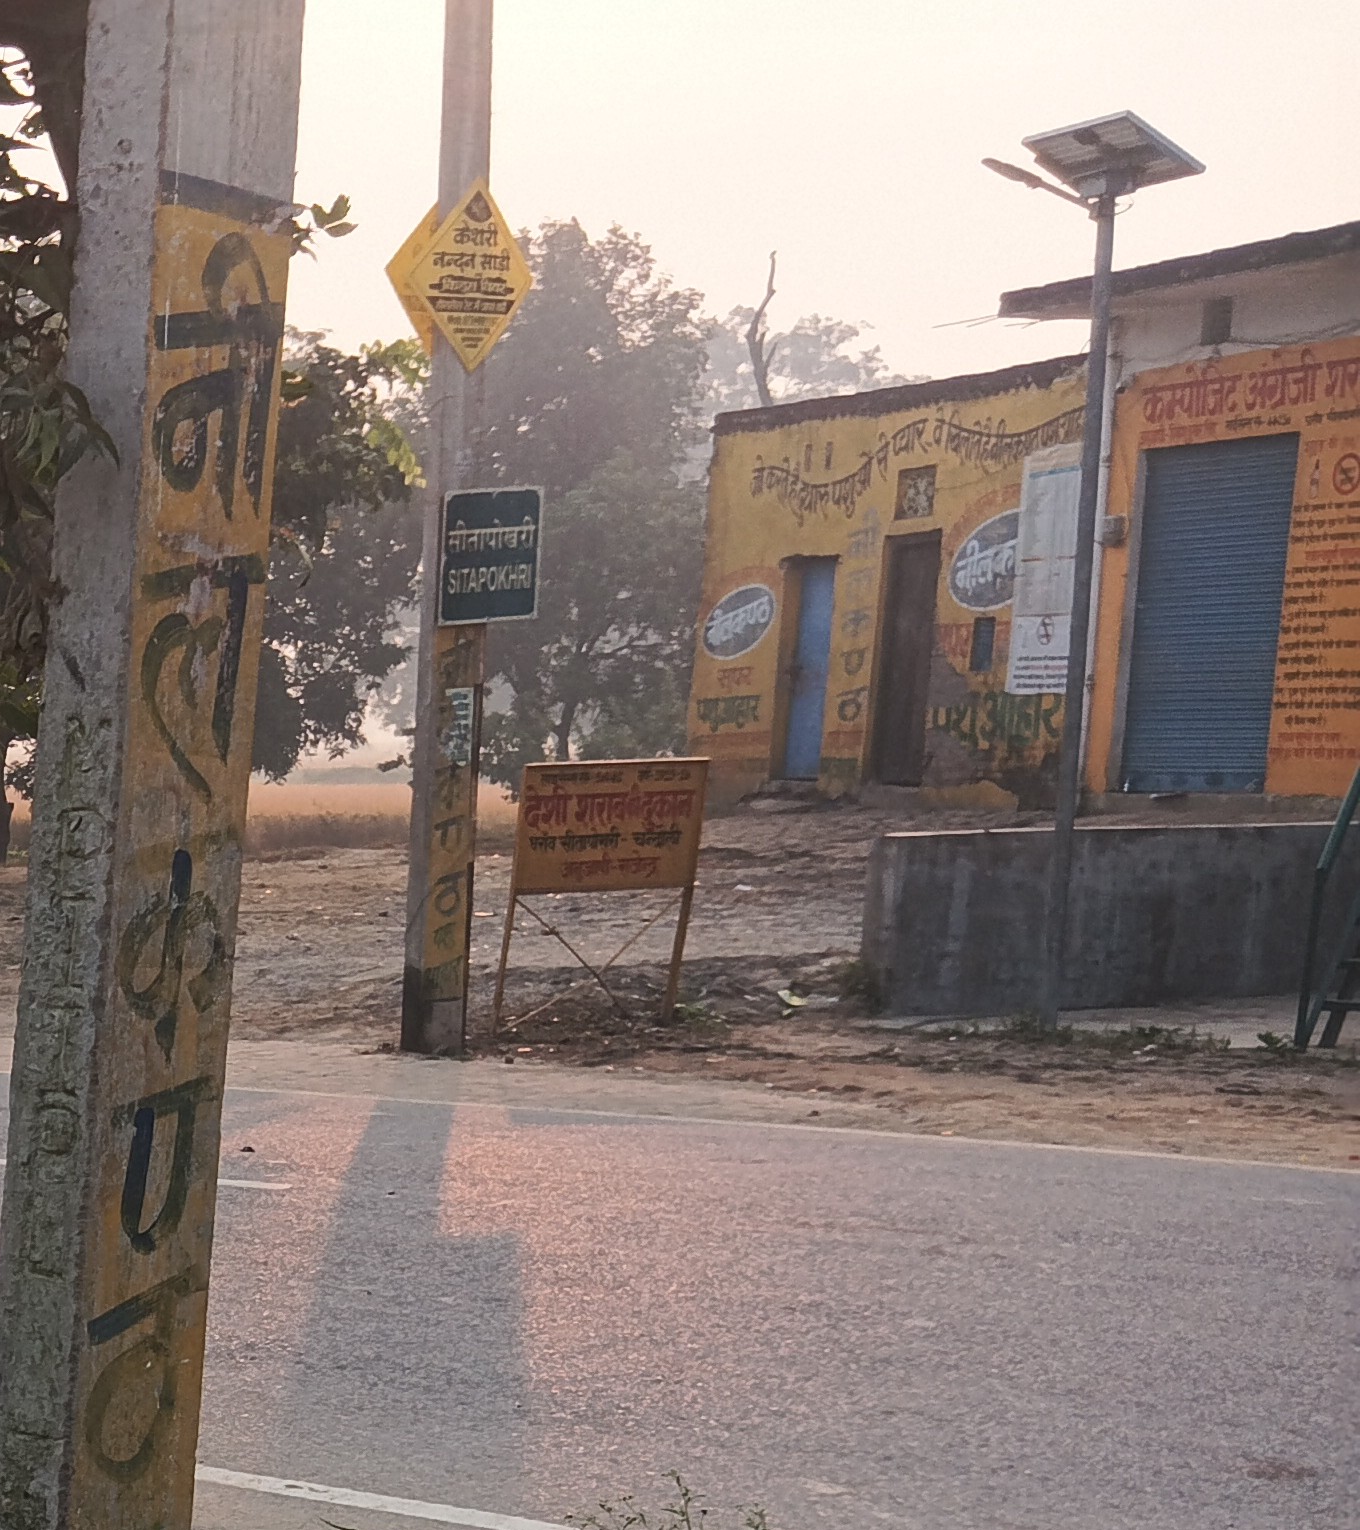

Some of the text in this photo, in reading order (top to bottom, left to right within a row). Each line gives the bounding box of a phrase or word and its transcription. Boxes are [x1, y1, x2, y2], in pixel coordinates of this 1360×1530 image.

[452, 221, 498, 247] केशरी
[432, 250, 477, 273] नन्दन
[448, 515, 536, 553] सीतापोखरी
[447, 562, 533, 595] SITAPOKHRI
[524, 784, 573, 831] देशी
